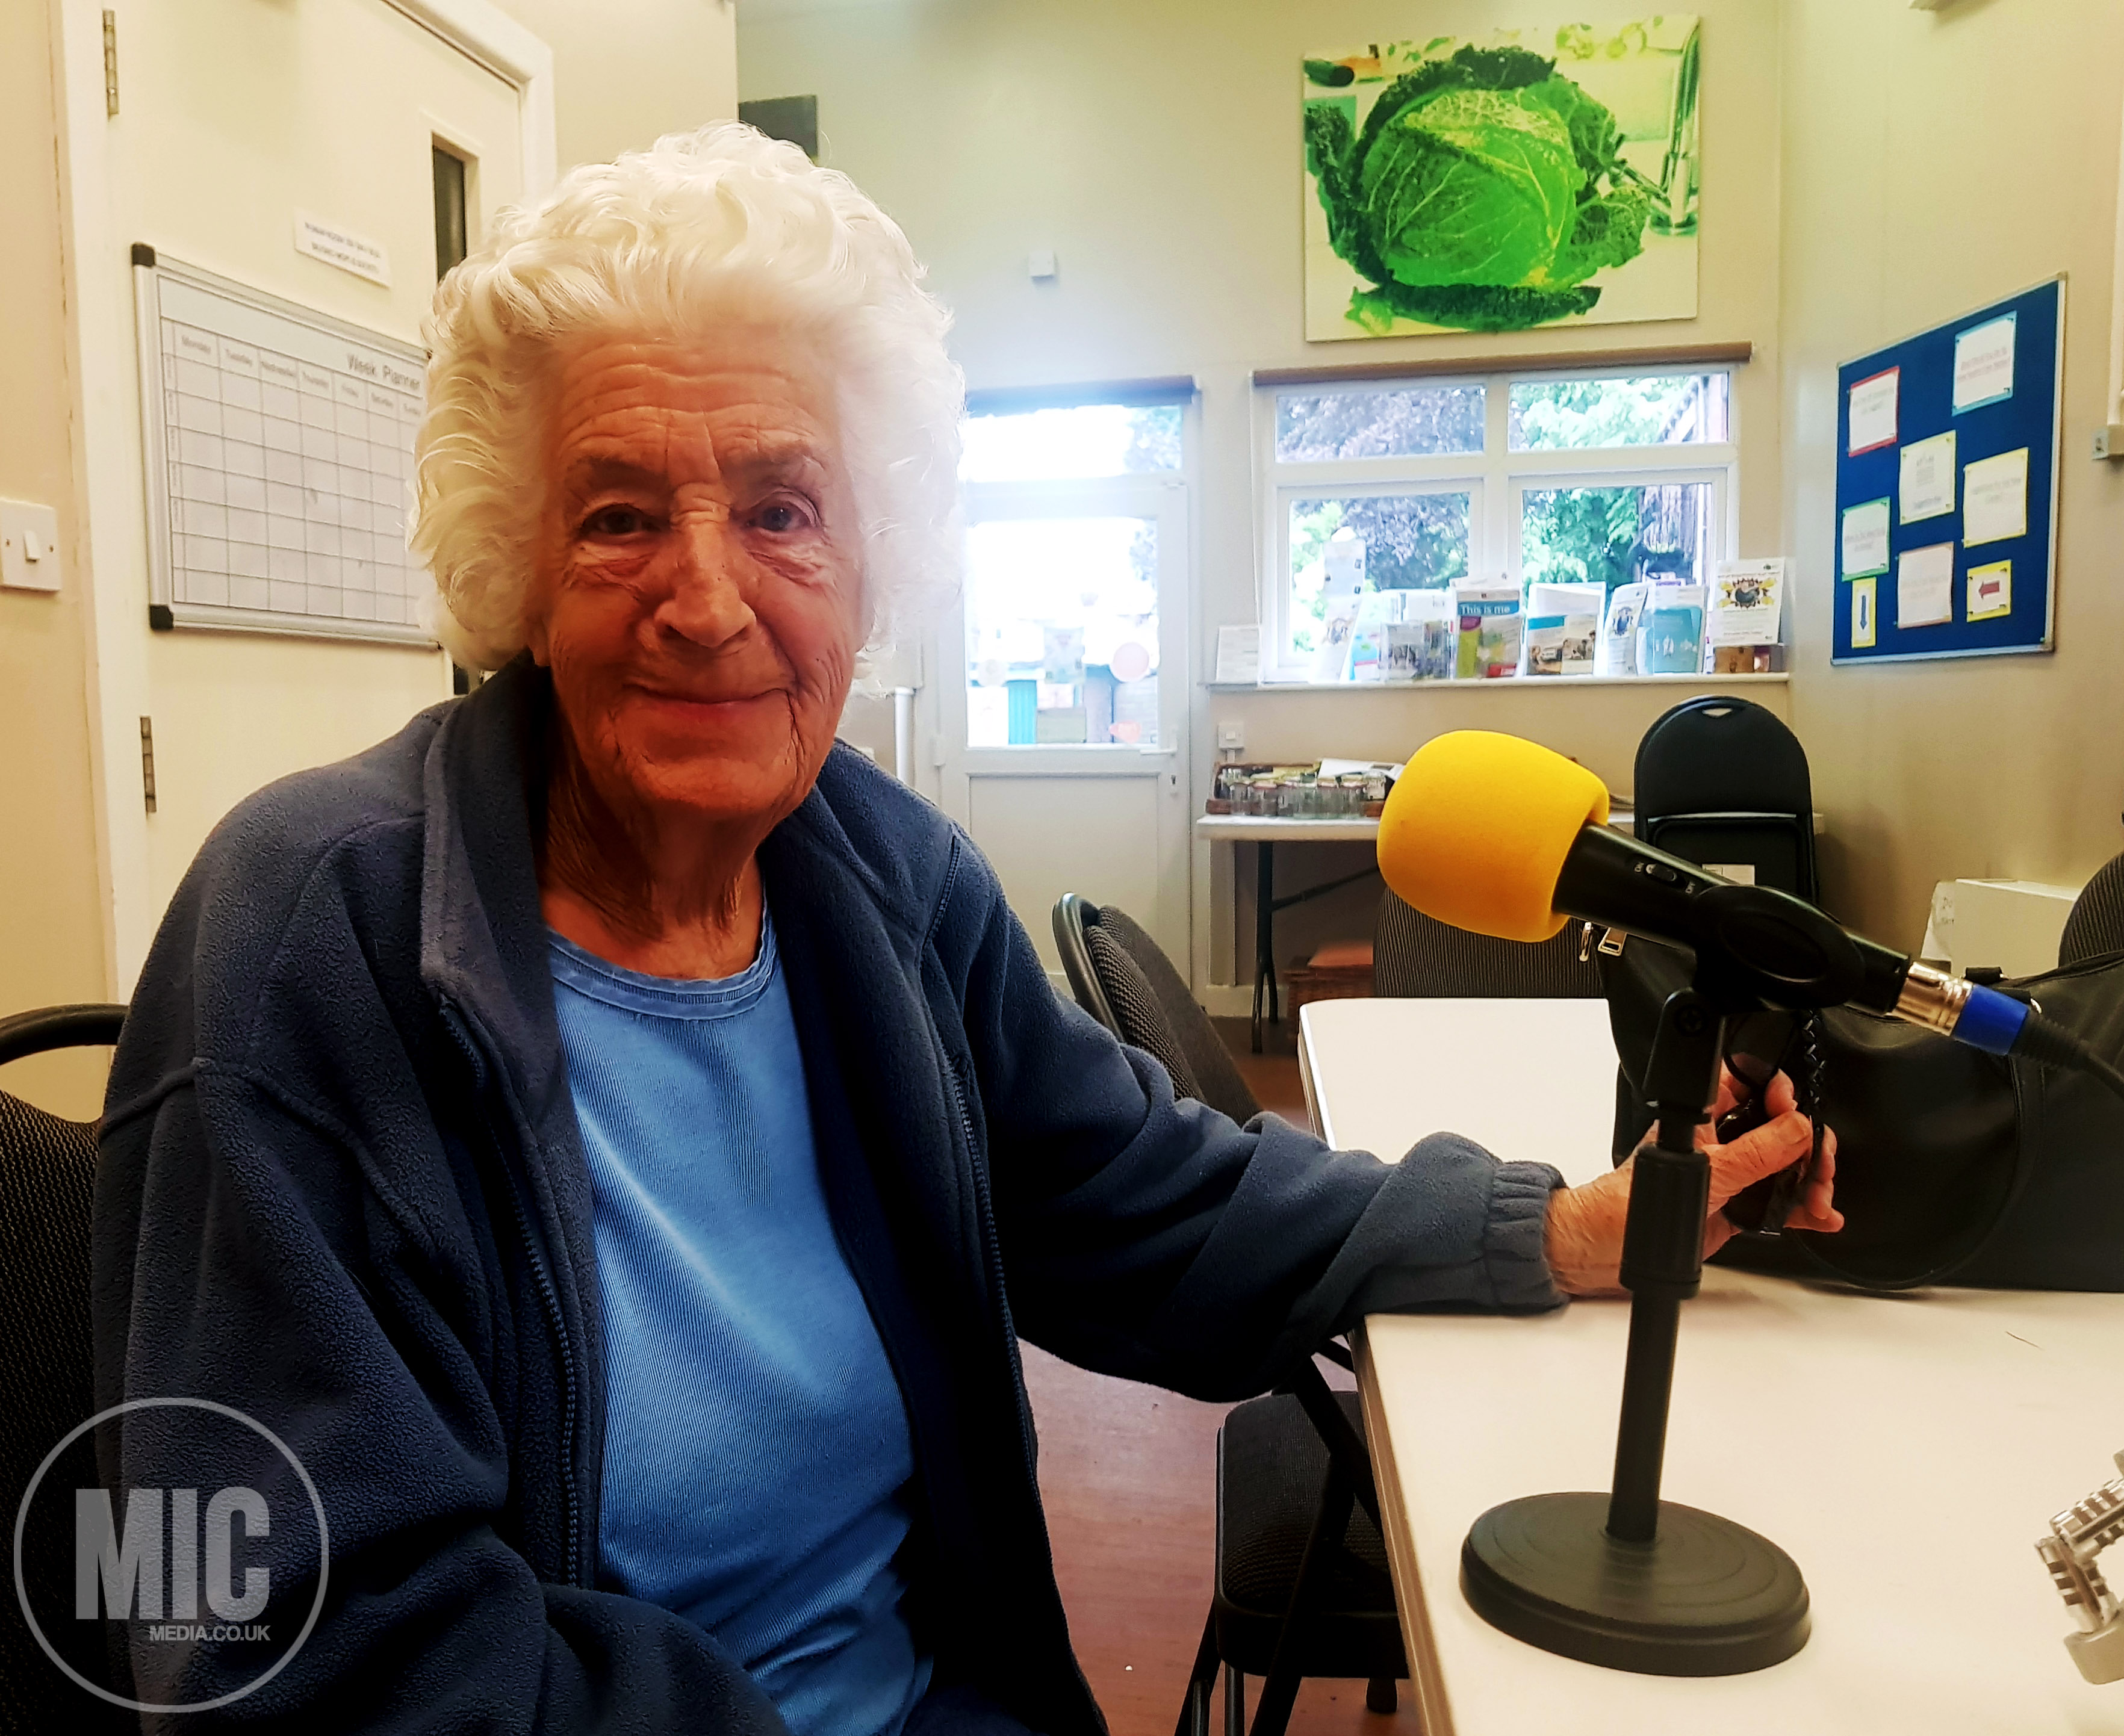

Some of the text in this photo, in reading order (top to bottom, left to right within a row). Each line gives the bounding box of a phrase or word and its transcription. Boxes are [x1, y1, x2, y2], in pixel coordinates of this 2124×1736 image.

[347, 353, 420, 390] Week Planner
[1459, 603, 1511, 615] This is me
